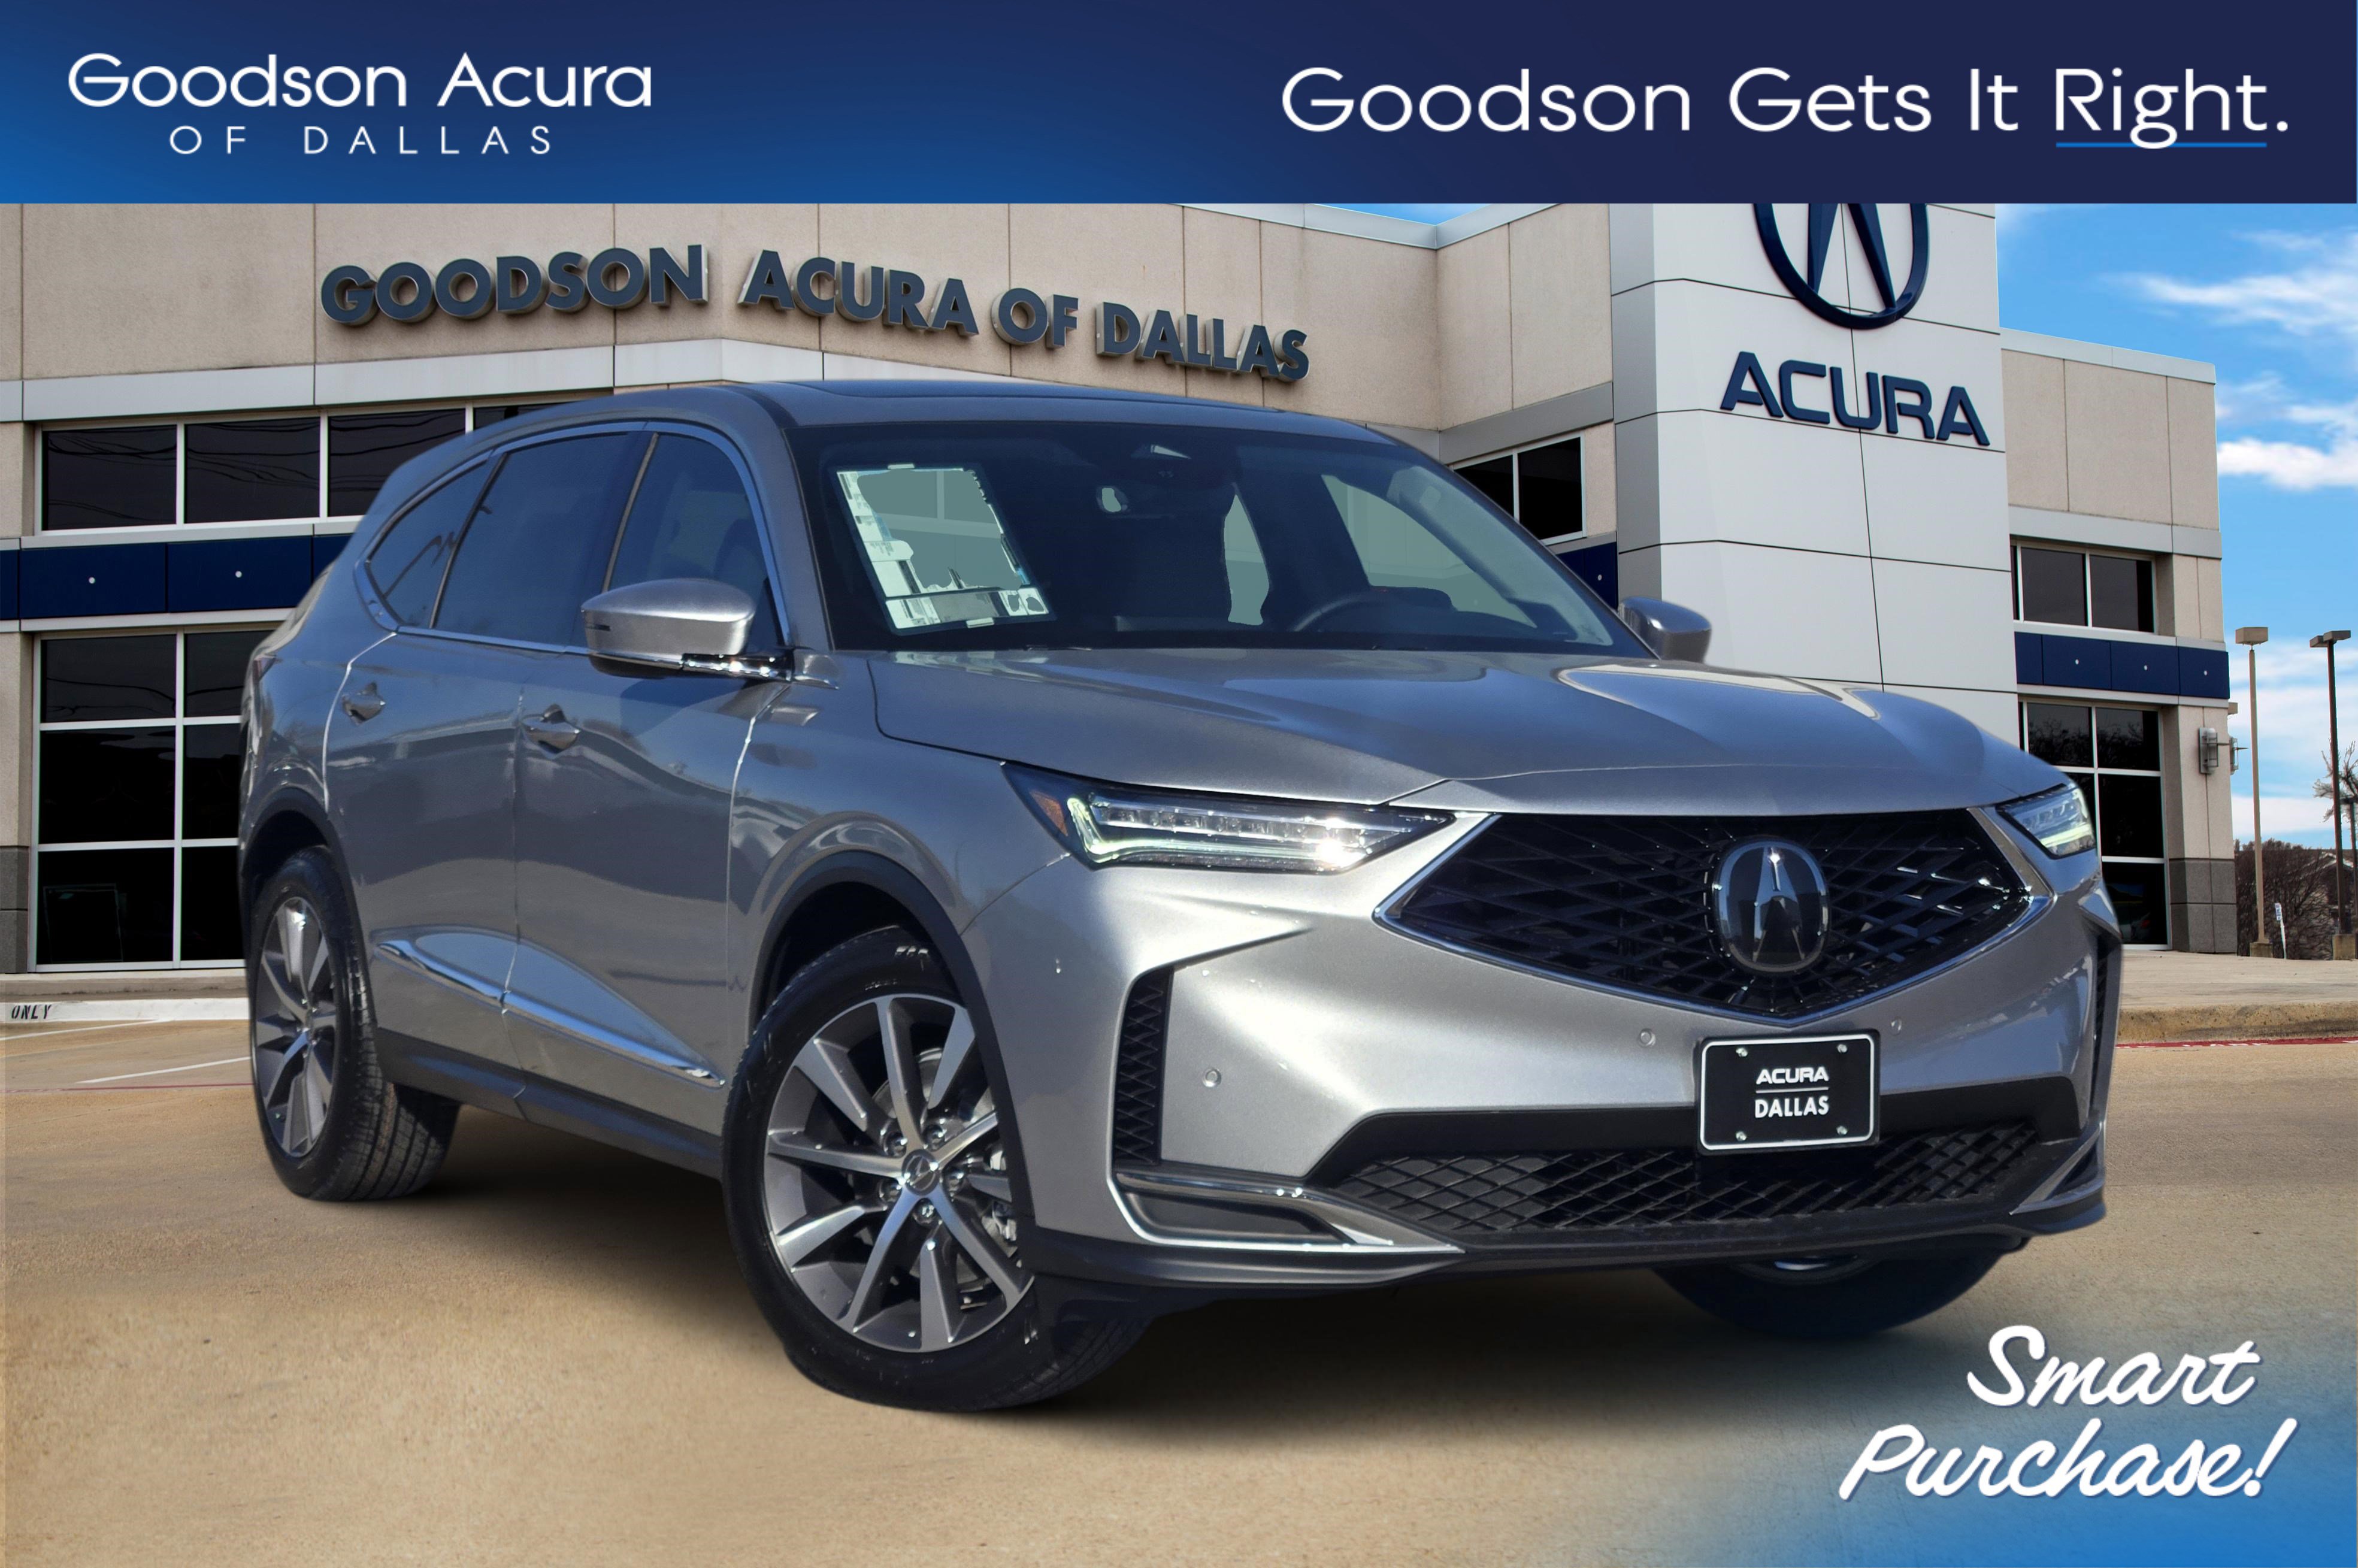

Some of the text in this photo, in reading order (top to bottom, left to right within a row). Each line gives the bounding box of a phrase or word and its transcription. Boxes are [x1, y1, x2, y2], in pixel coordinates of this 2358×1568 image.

[321, 244, 1310, 383] GOODSON ACURA OF DALLAS
[1720, 350, 1991, 446] ACURA
[11, 1004, 52, 1020] ONLY
[1755, 1066, 1830, 1085] ACURA
[1755, 1095, 1830, 1119] DALLAS
